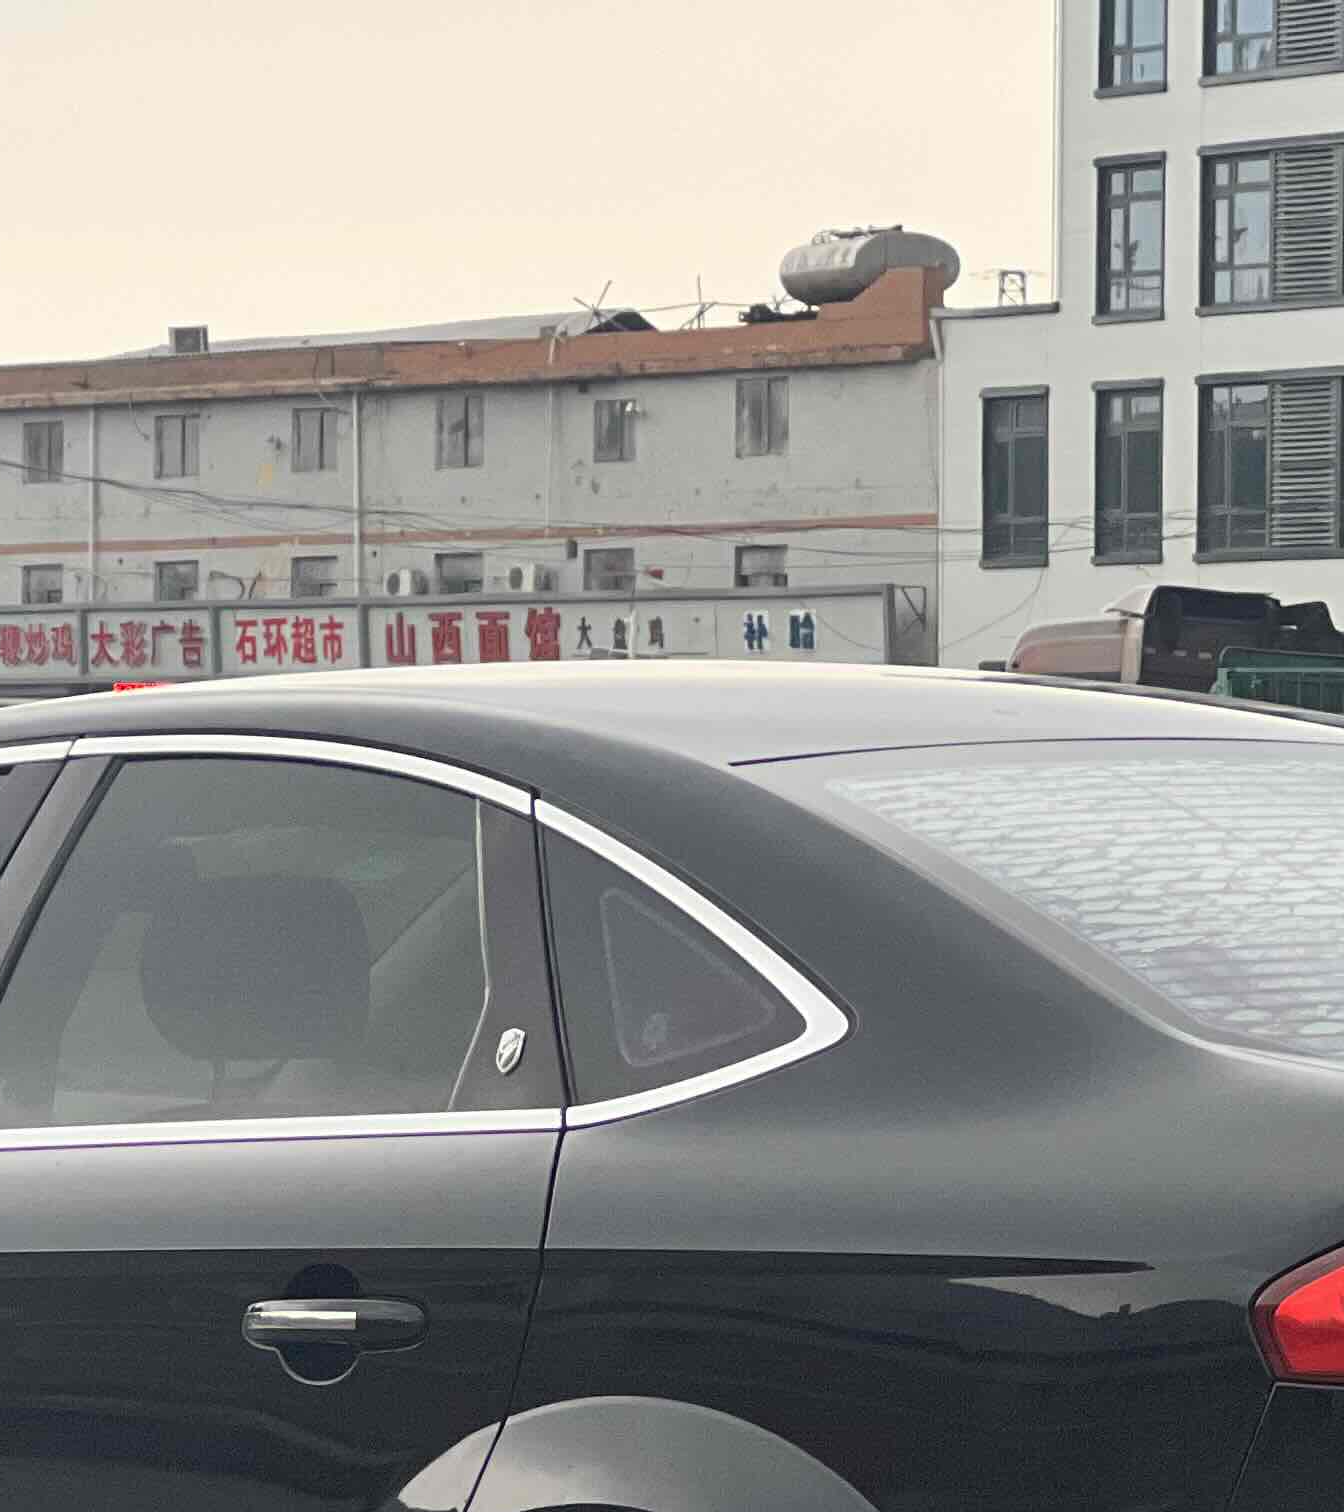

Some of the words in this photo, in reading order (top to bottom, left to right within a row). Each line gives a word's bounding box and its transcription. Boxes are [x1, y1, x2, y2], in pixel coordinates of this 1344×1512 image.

[234, 615, 344, 665] 石环超市
[386, 607, 561, 665] 山西面馆
